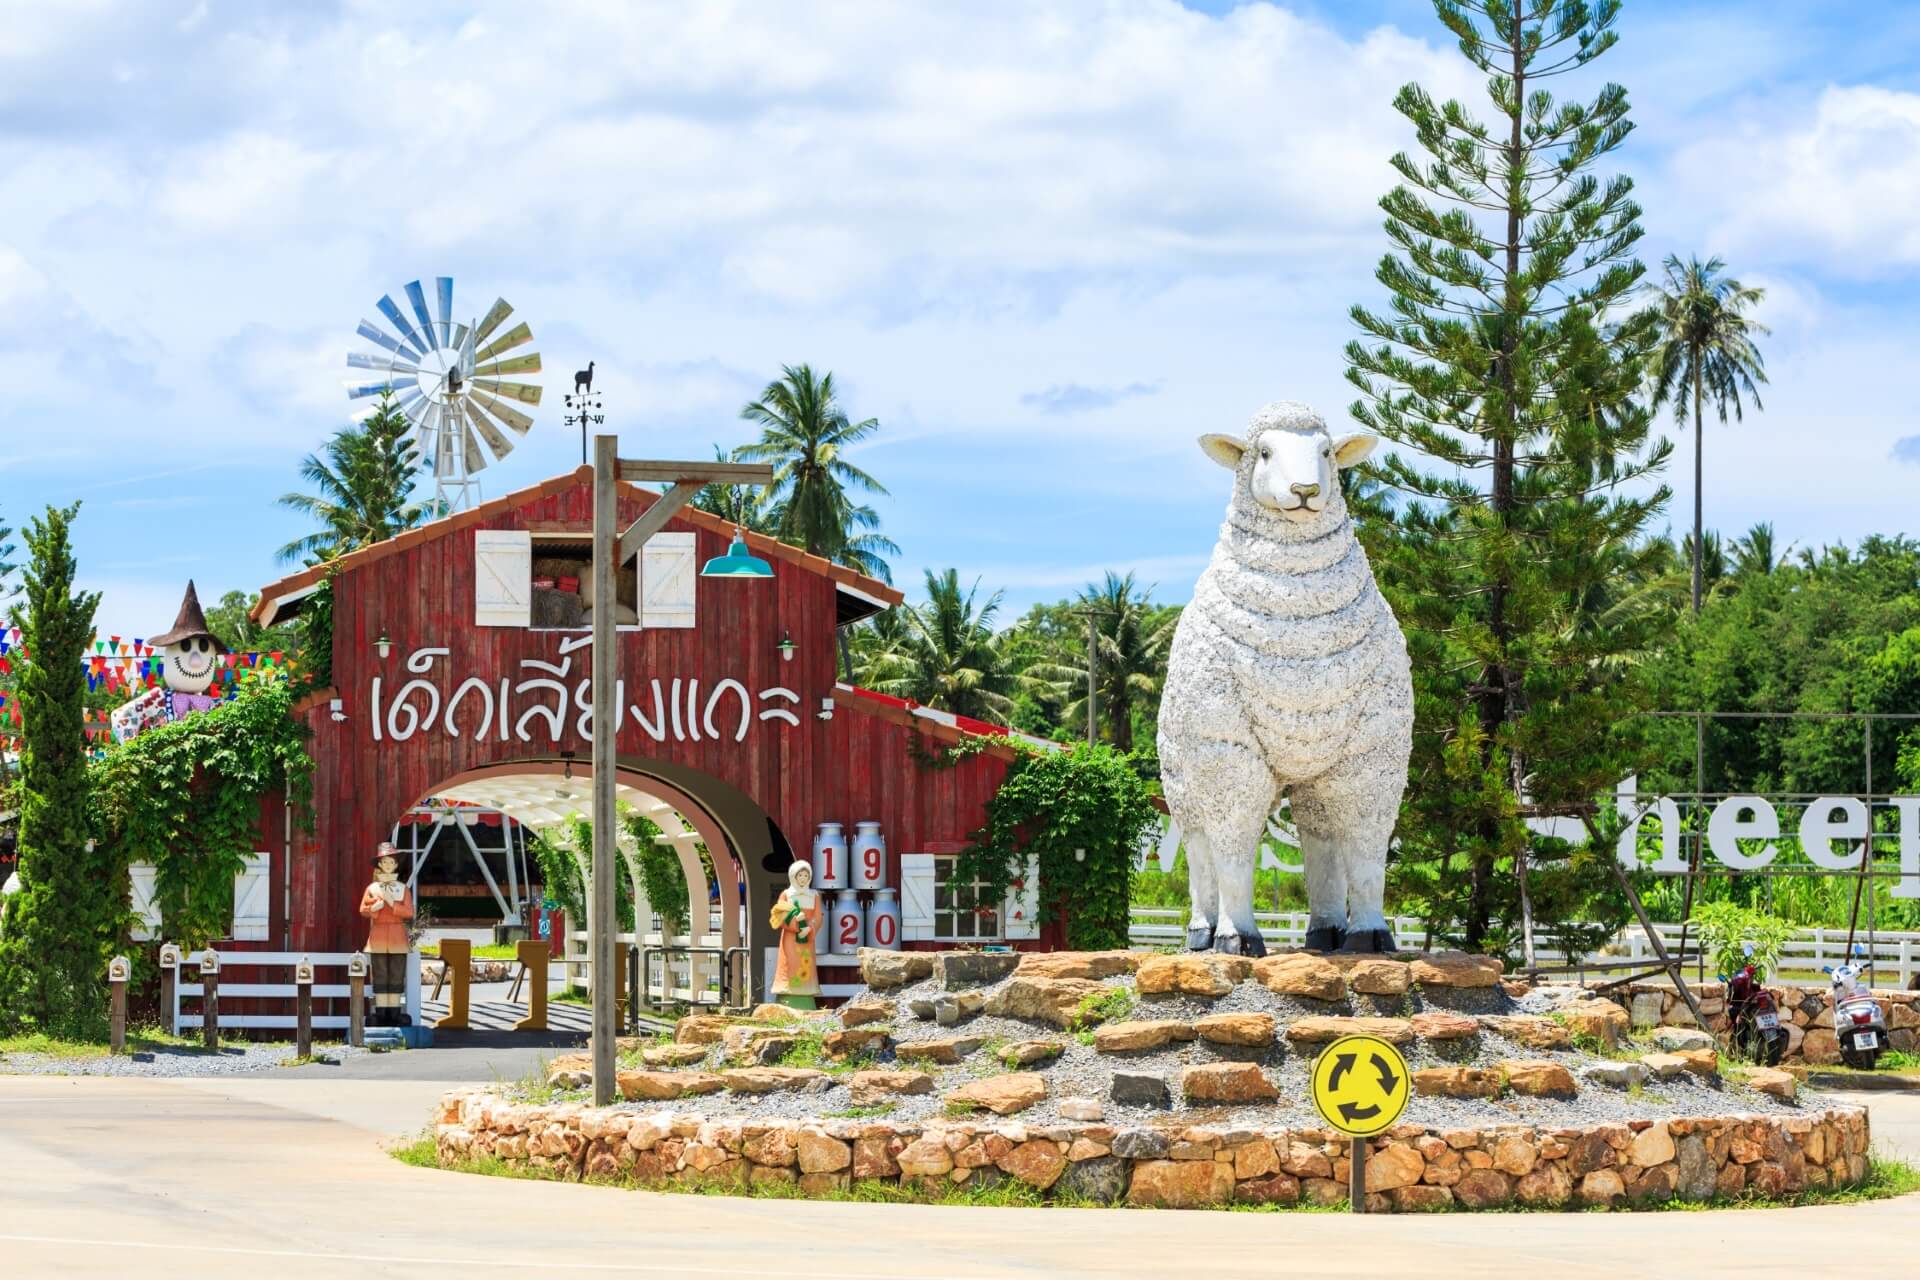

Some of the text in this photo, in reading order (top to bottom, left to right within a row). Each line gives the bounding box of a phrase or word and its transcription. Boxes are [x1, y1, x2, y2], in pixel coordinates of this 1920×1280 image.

[371, 634, 800, 742] เด็กเลี้ยงแกะ
[822, 847, 881, 880] 1 9
[840, 914, 895, 946] 2 0
